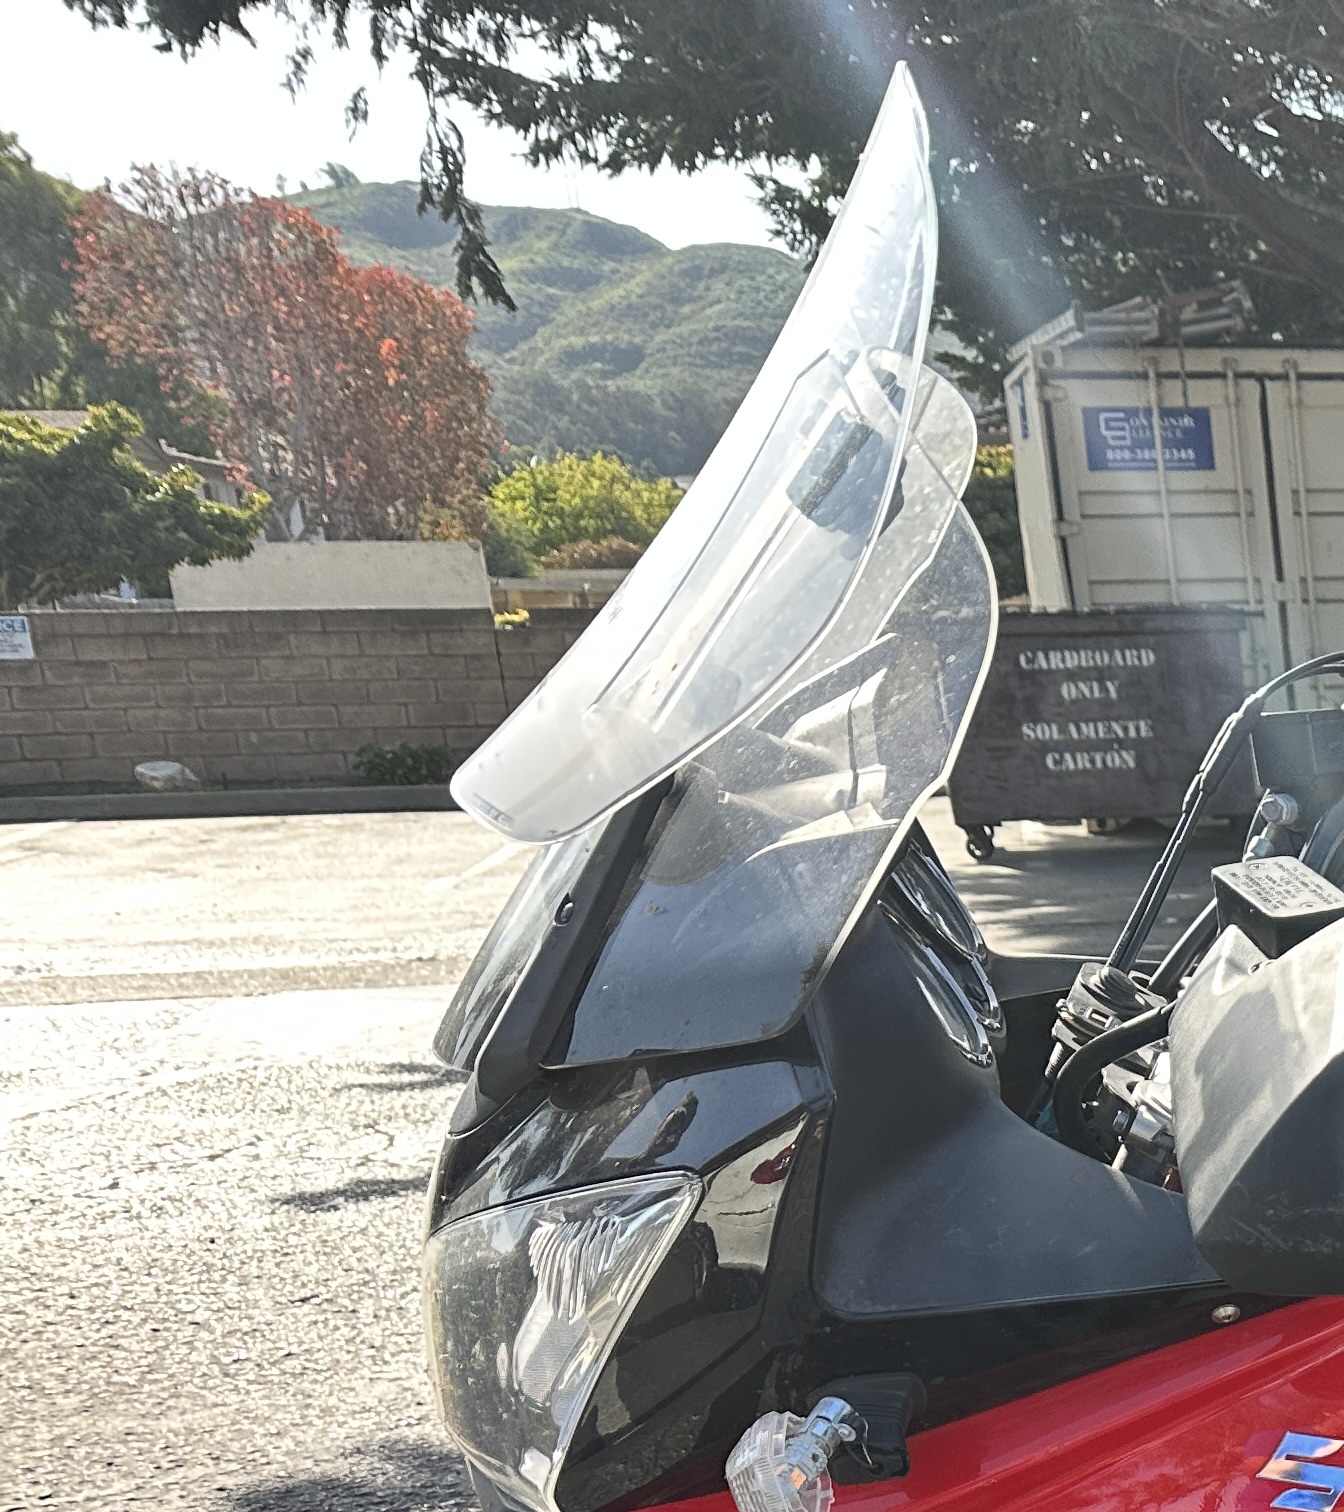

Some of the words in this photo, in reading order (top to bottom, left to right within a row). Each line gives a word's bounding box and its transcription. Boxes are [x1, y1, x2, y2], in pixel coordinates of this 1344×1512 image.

[1018, 648, 1156, 670] CARDBOARD
[1060, 680, 1120, 701] ONLY
[1021, 719, 1154, 741] SOLAMENTE
